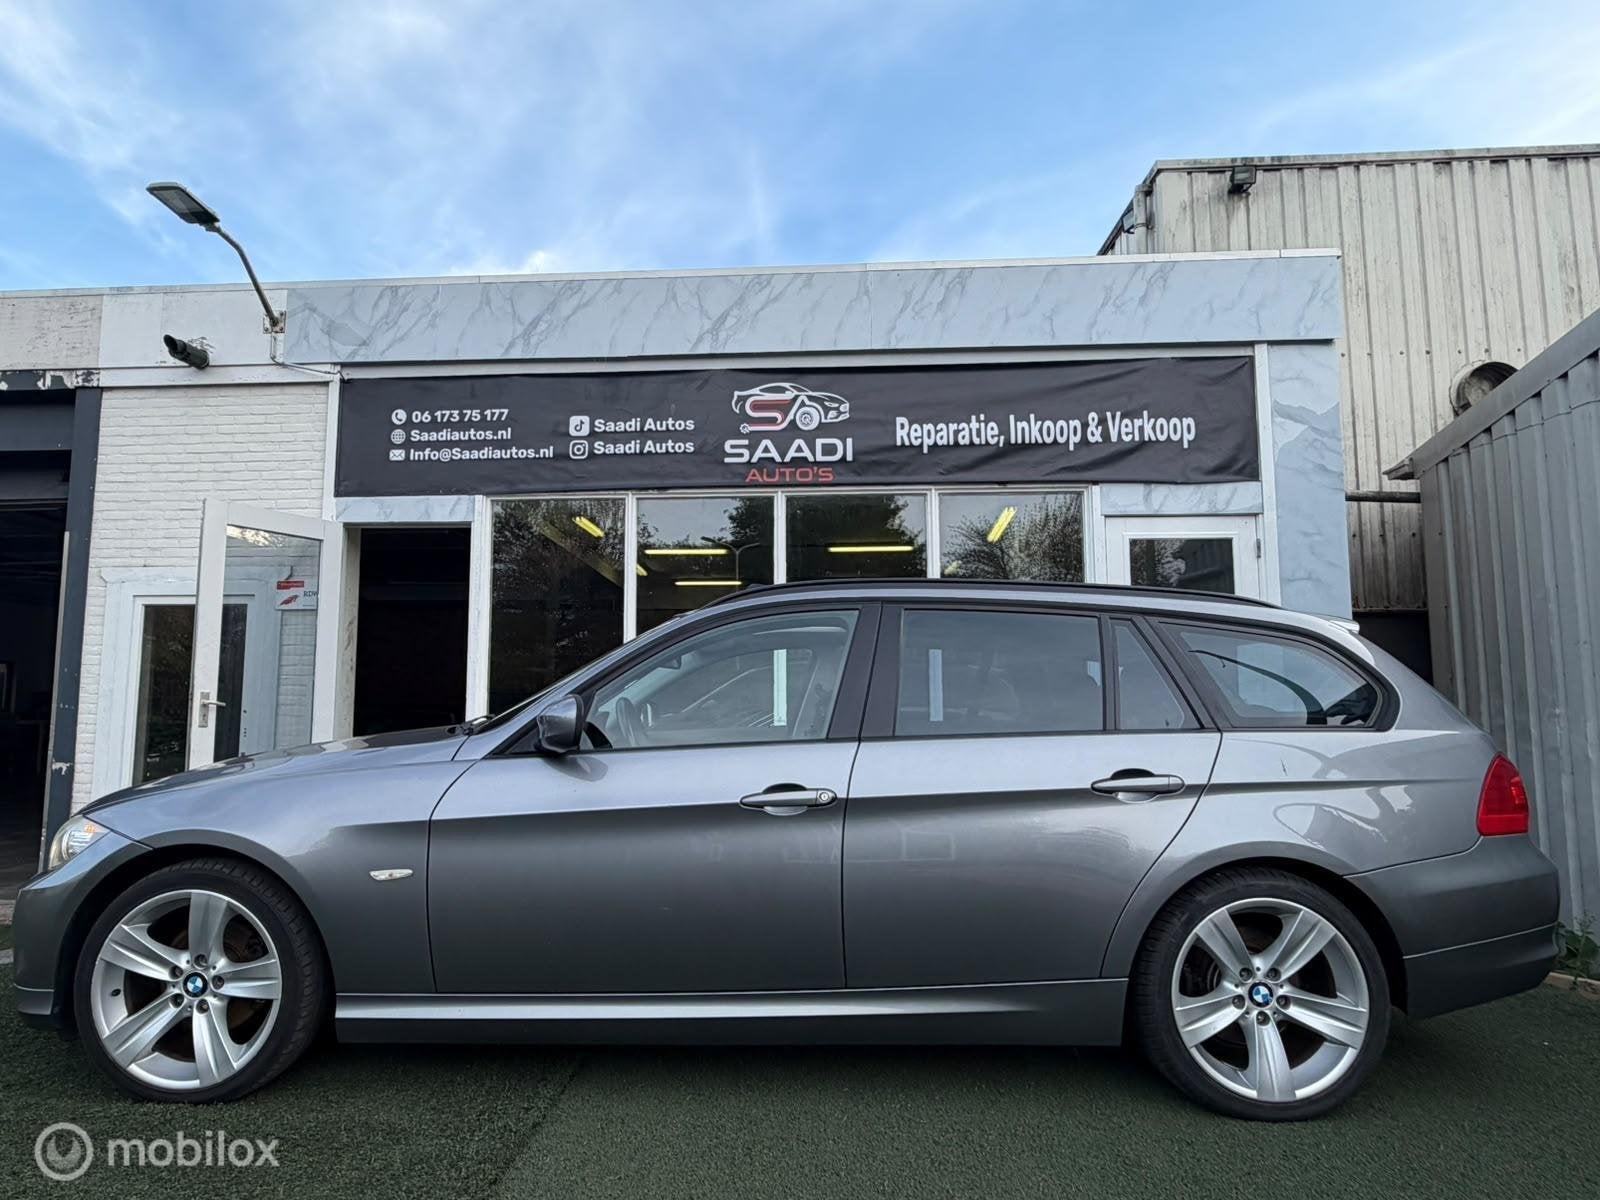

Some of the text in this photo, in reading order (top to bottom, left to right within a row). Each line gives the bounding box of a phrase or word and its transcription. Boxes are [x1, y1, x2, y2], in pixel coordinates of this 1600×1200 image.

[412, 408, 509, 423] 06 173 75 177
[594, 417, 695, 432] Saadi Autos
[895, 410, 1196, 453] Reparatie, Inkoop & Verkoop
[410, 427, 511, 441] Saadiautos.nl
[409, 445, 554, 462] Info@Saadiautos.nl
[593, 439, 695, 454] Saadi Autos
[724, 437, 853, 463] SAADI
[745, 467, 834, 483] AUTO'S
